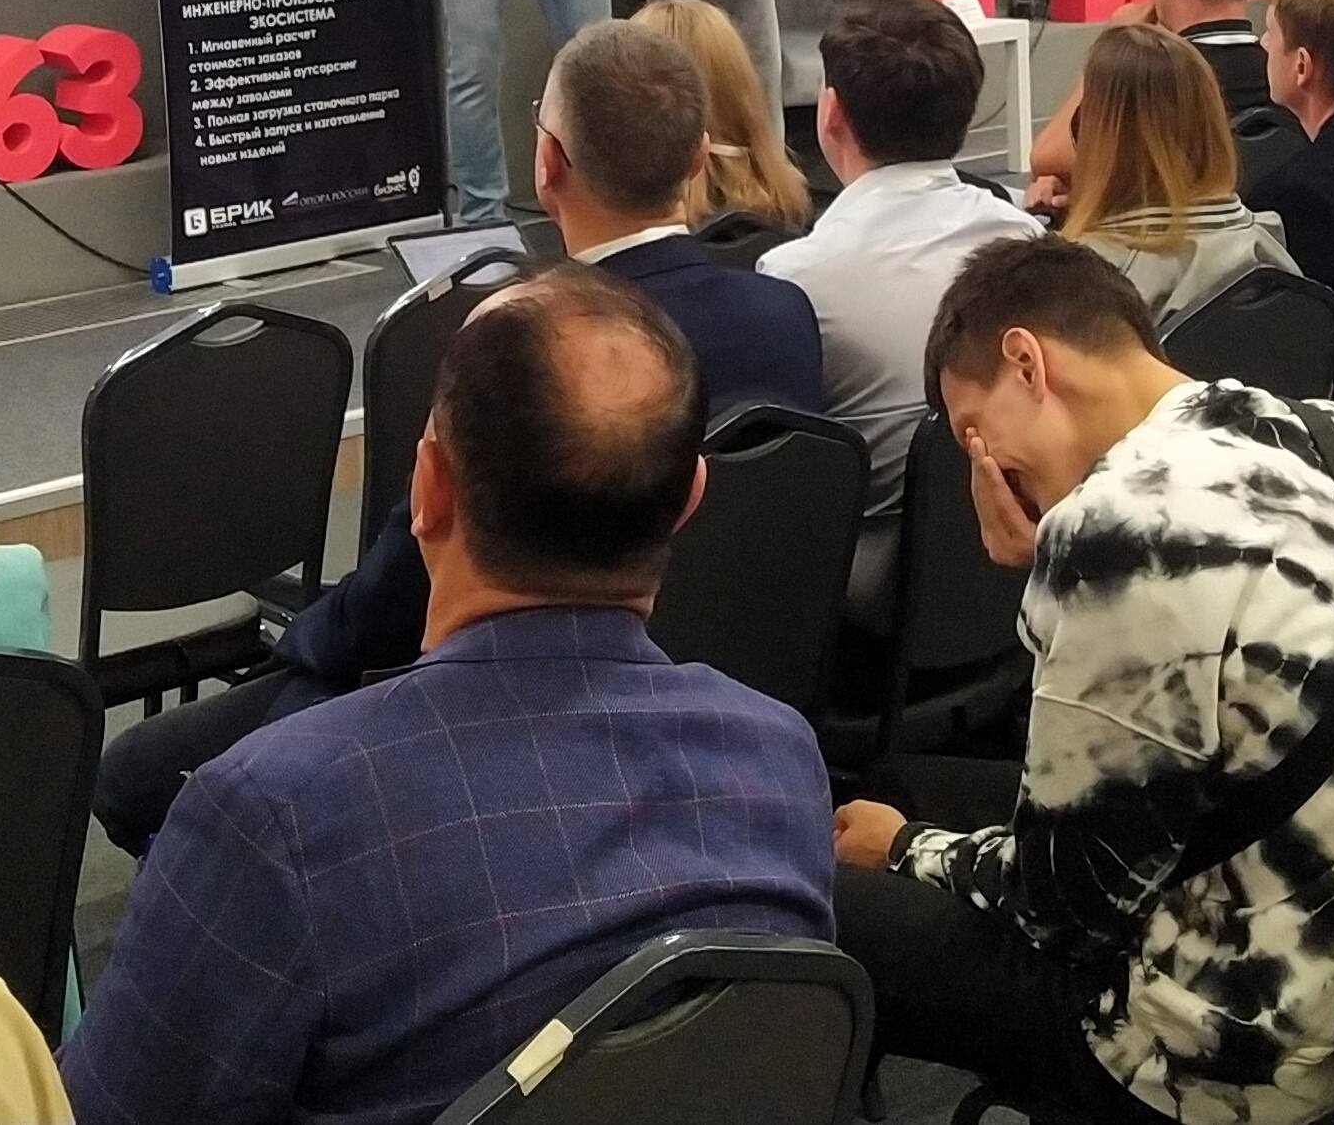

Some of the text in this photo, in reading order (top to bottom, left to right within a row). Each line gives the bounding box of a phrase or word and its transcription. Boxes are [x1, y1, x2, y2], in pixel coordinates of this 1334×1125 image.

[249, 7, 336, 30] ЭКОСИСТЕМА
[188, 29, 317, 55] 1. Мгновенный расчет
[188, 49, 302, 74] стоимости заказов
[190, 80, 202, 93] 2.
[204, 67, 292, 92] Эффективный
[191, 87, 293, 111] между заводами
[193, 117, 205, 130] 3.
[207, 113, 250, 129] Полная
[253, 104, 302, 122] загрузка
[195, 135, 206, 148] 4.
[208, 127, 261, 147] Быстрый
[264, 122, 303, 138] запуск
[199, 140, 286, 167] новых изделий
[210, 198, 275, 225] БРИК
